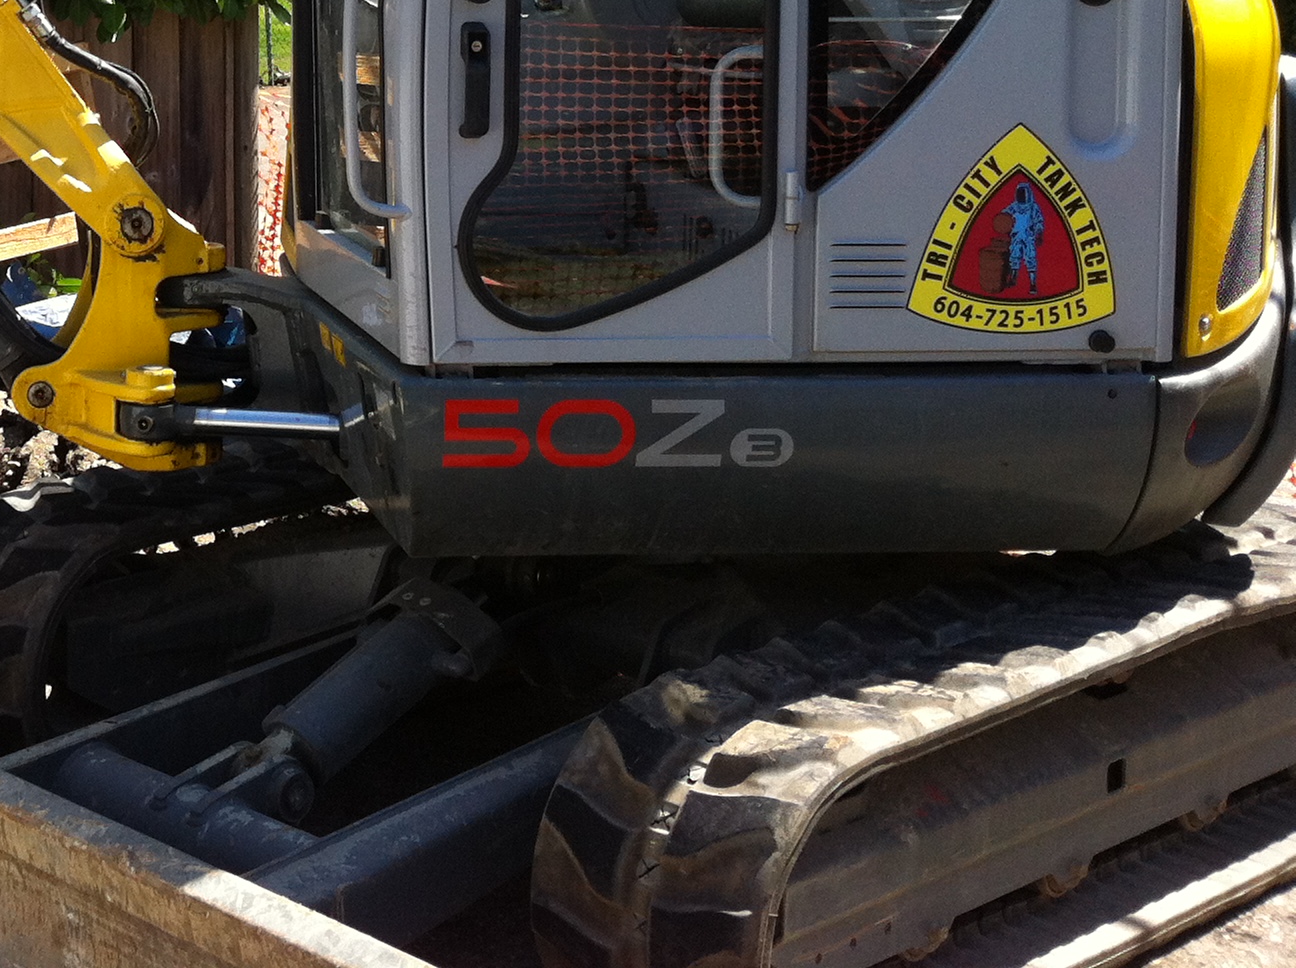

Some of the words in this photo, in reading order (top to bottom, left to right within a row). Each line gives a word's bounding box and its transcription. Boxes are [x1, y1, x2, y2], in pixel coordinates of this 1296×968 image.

[921, 238, 954, 282] TRI
[952, 155, 1004, 214] CITY
[1036, 155, 1087, 219] TANK
[1075, 219, 1109, 286] TECH
[933, 296, 1088, 329] 604-725-1515
